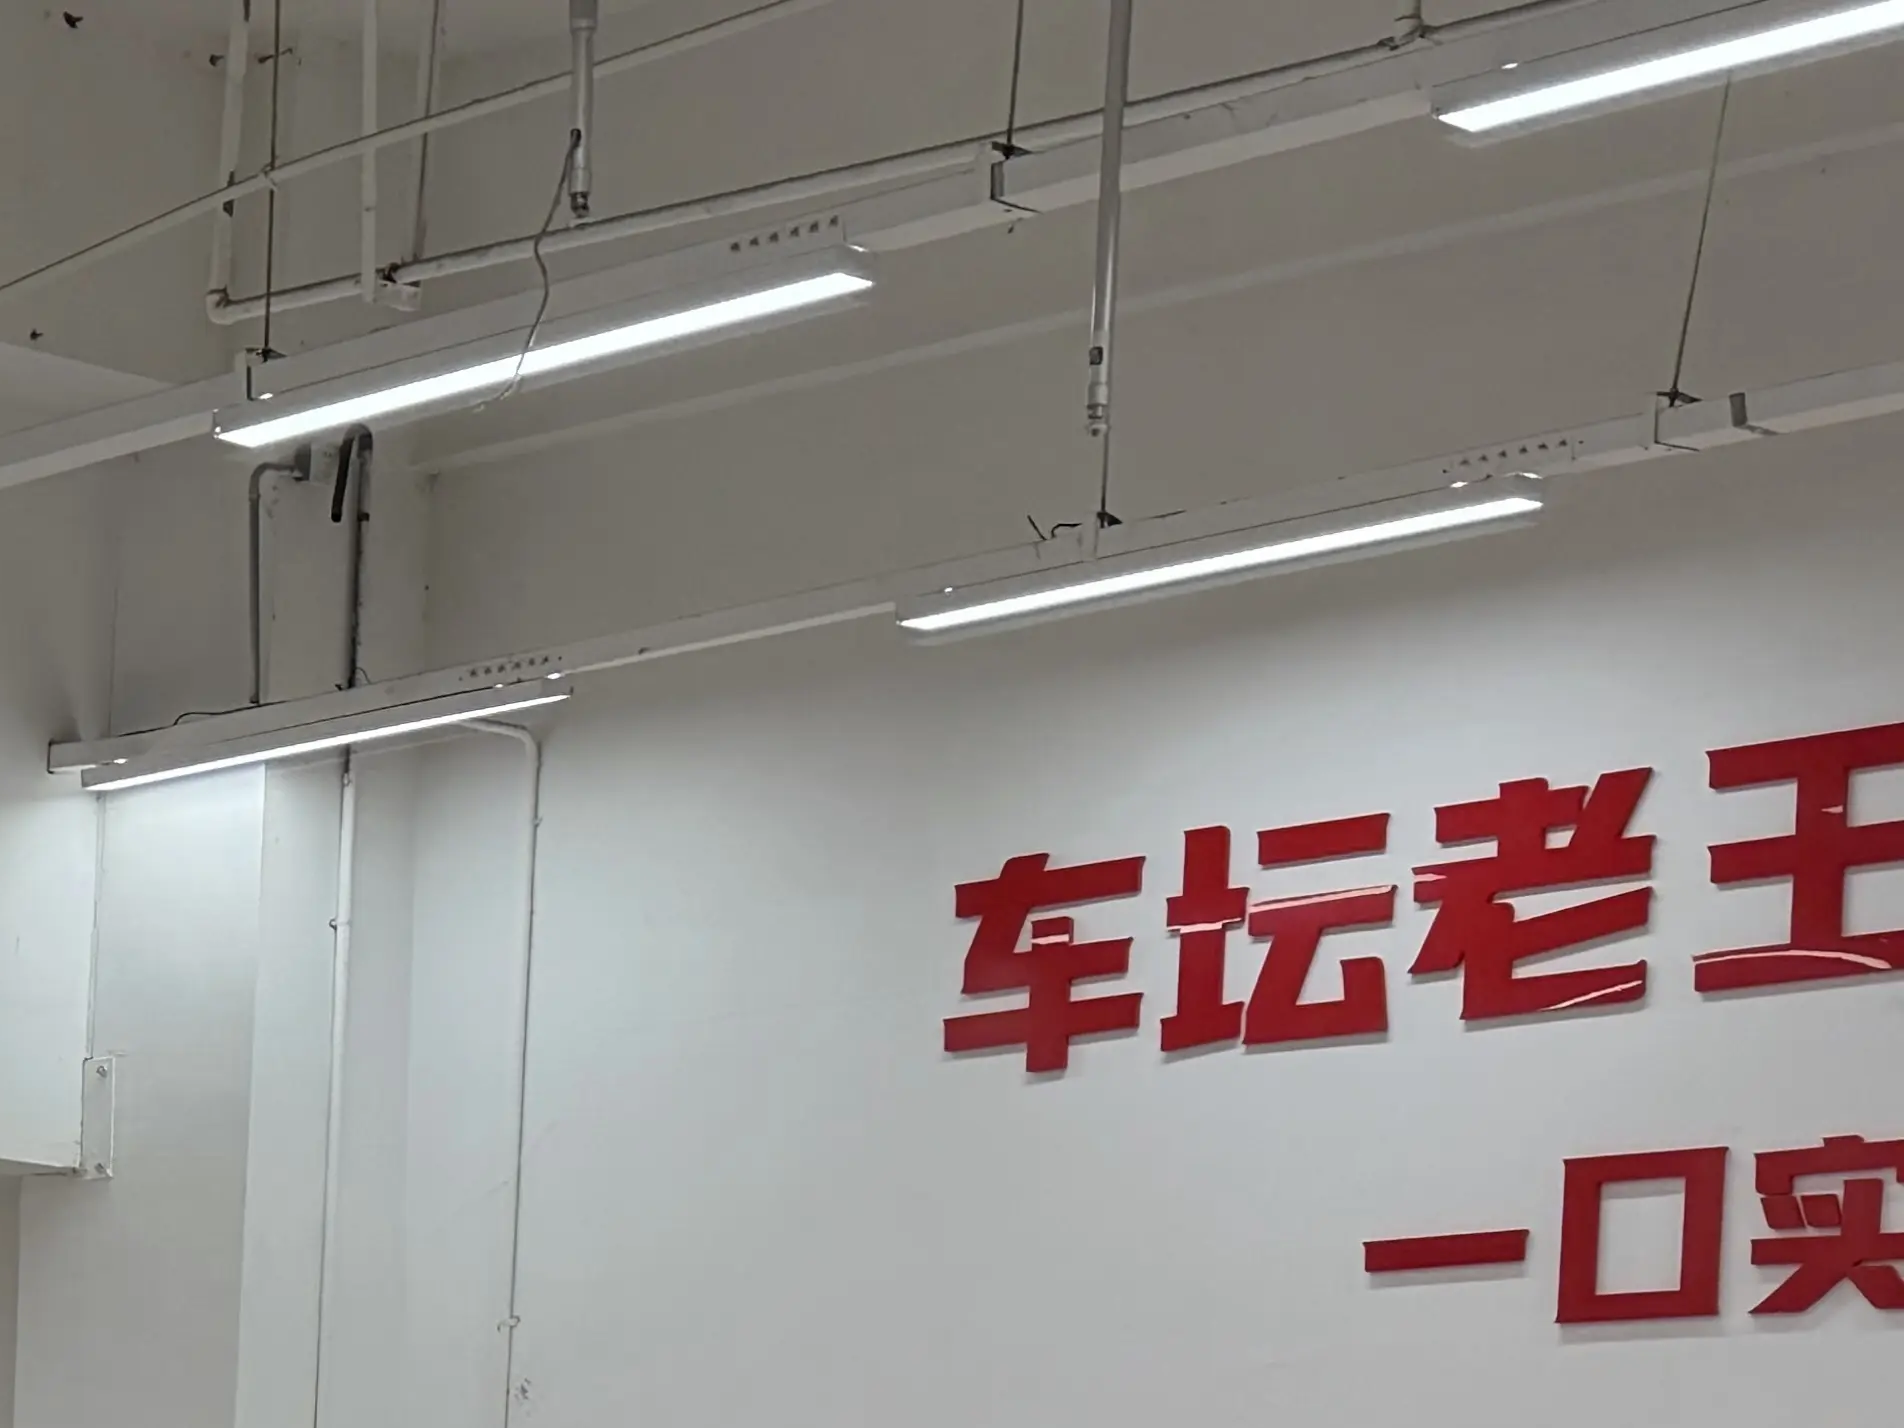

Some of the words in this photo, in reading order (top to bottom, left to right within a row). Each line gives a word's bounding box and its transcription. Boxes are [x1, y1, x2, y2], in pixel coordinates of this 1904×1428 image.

[943, 722, 1904, 1073] 车坛老王
[1363, 1135, 1904, 1324] 一口实
